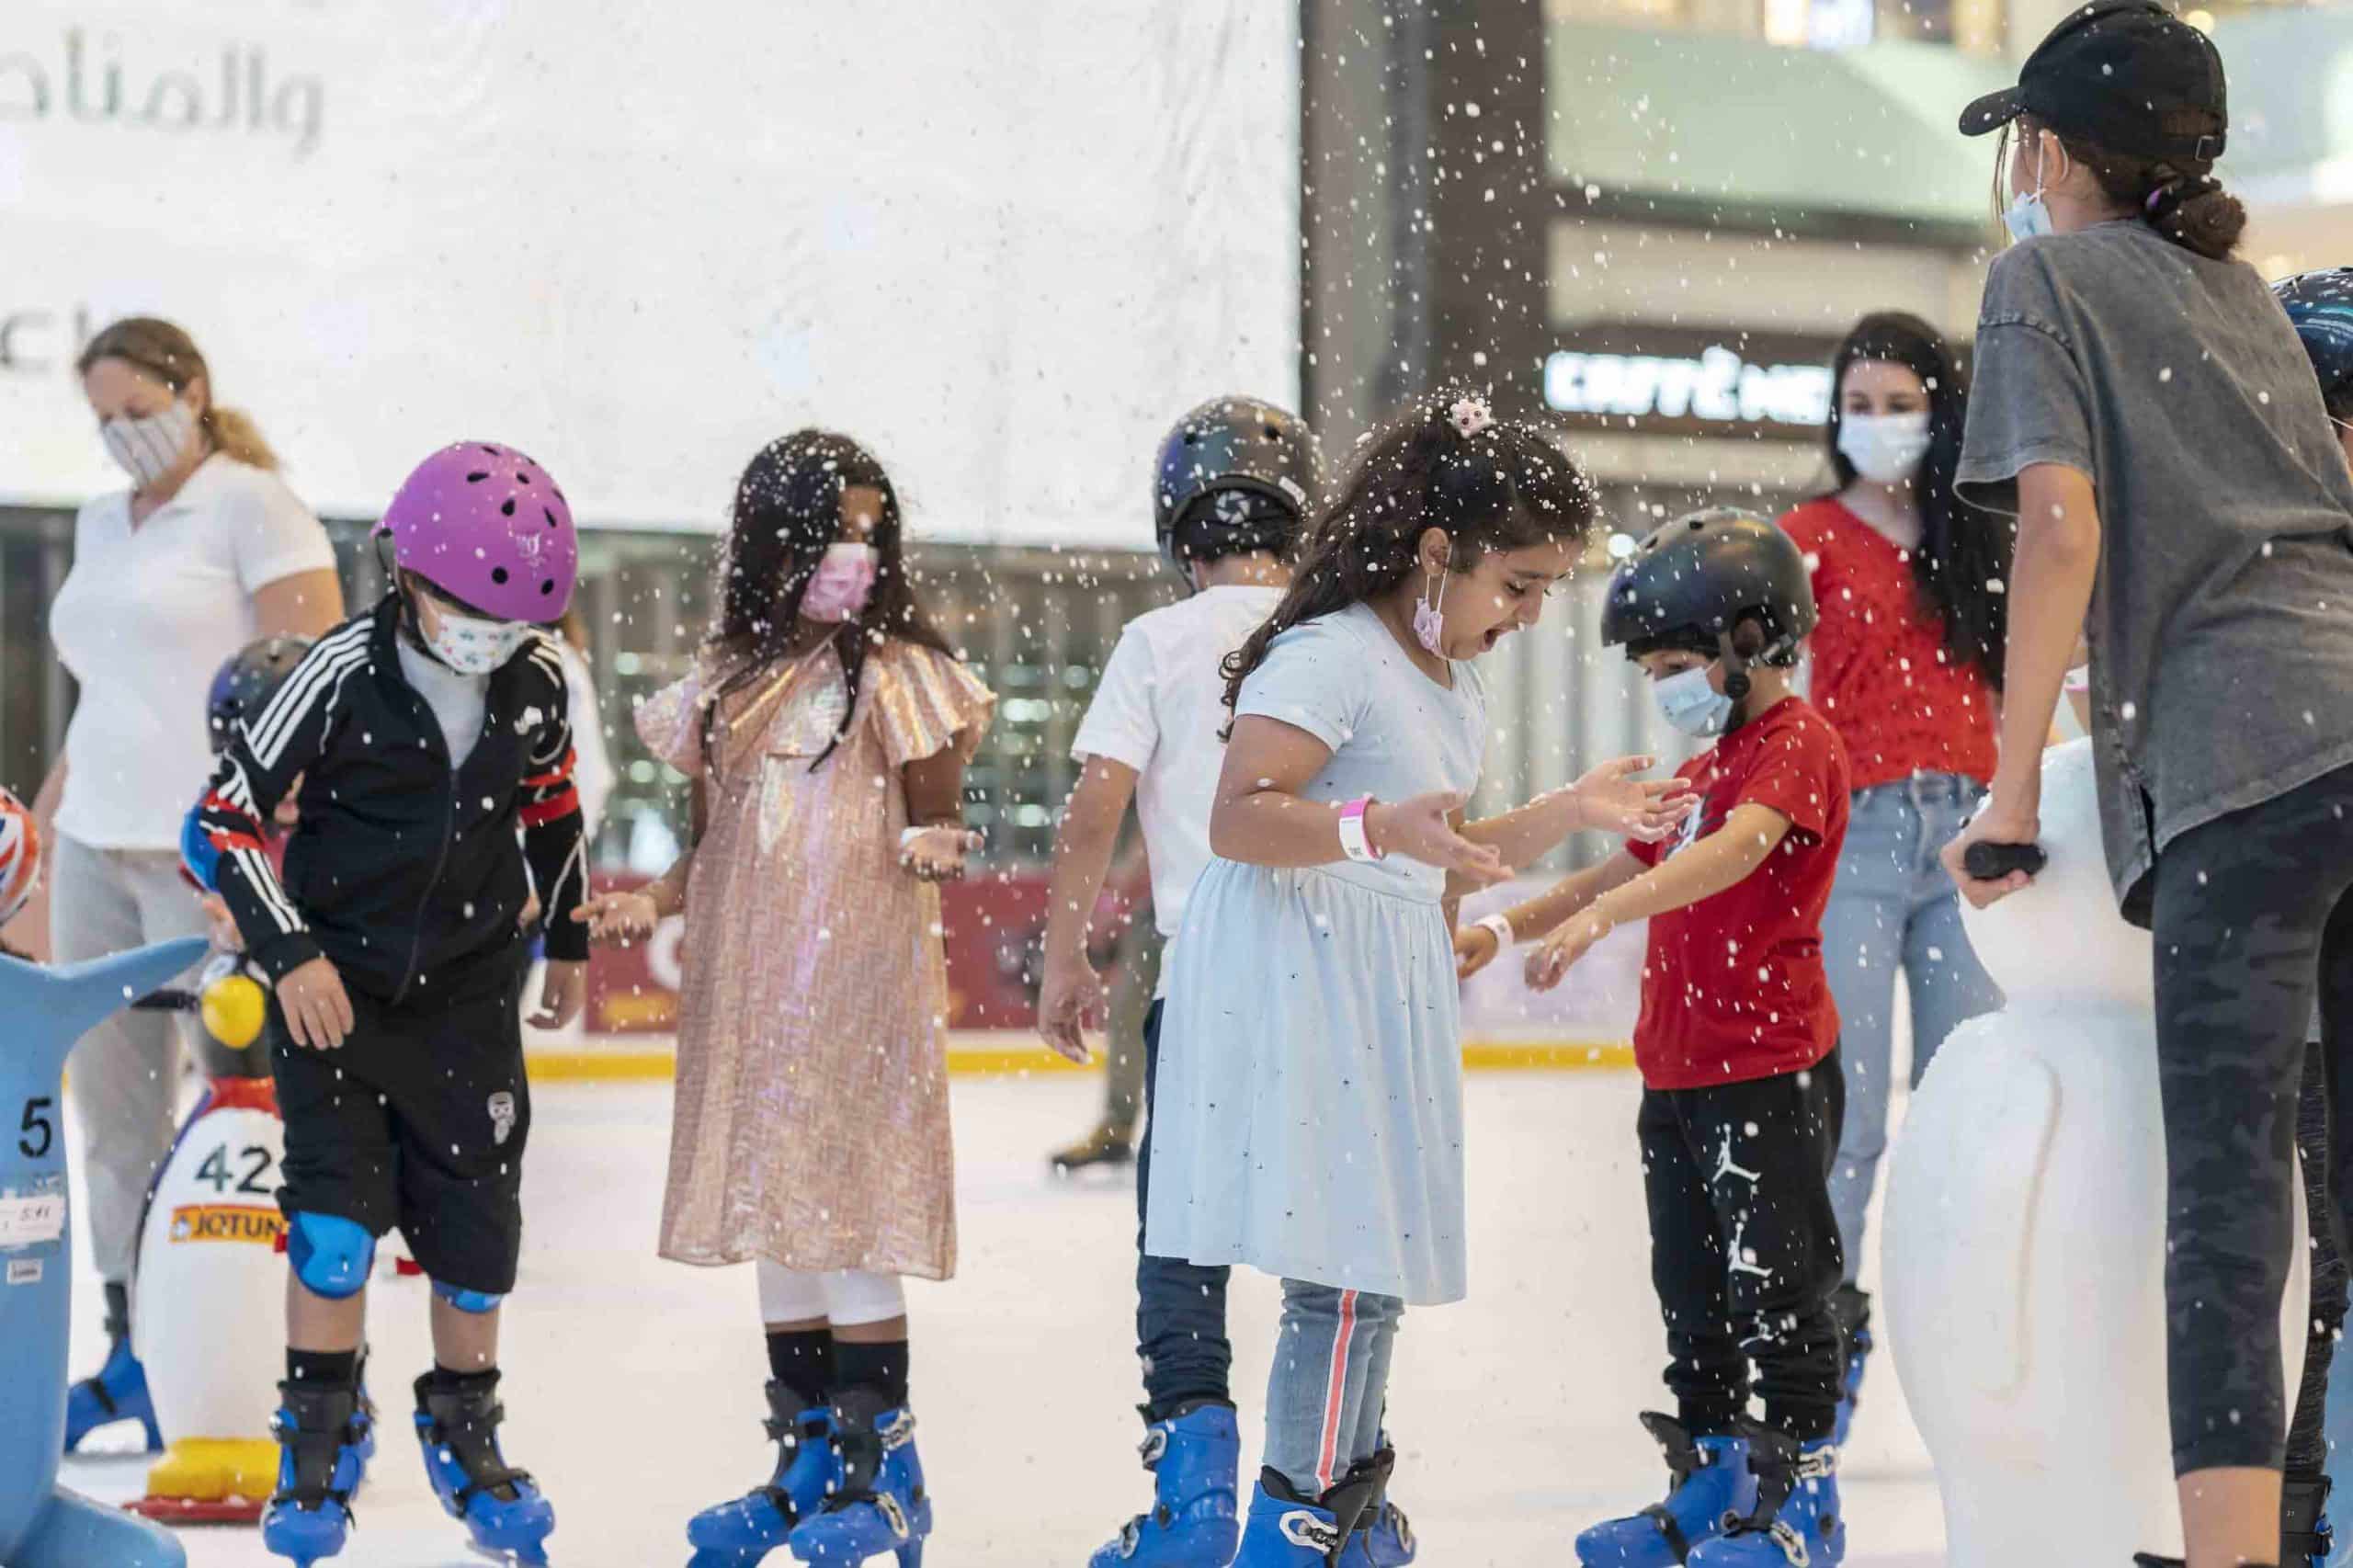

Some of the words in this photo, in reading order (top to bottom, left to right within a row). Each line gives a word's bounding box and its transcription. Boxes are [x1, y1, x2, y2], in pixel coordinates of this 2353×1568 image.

[18, 1096, 52, 1160] 5
[195, 1142, 272, 1194] 42
[194, 1212, 283, 1238] JOTUN
